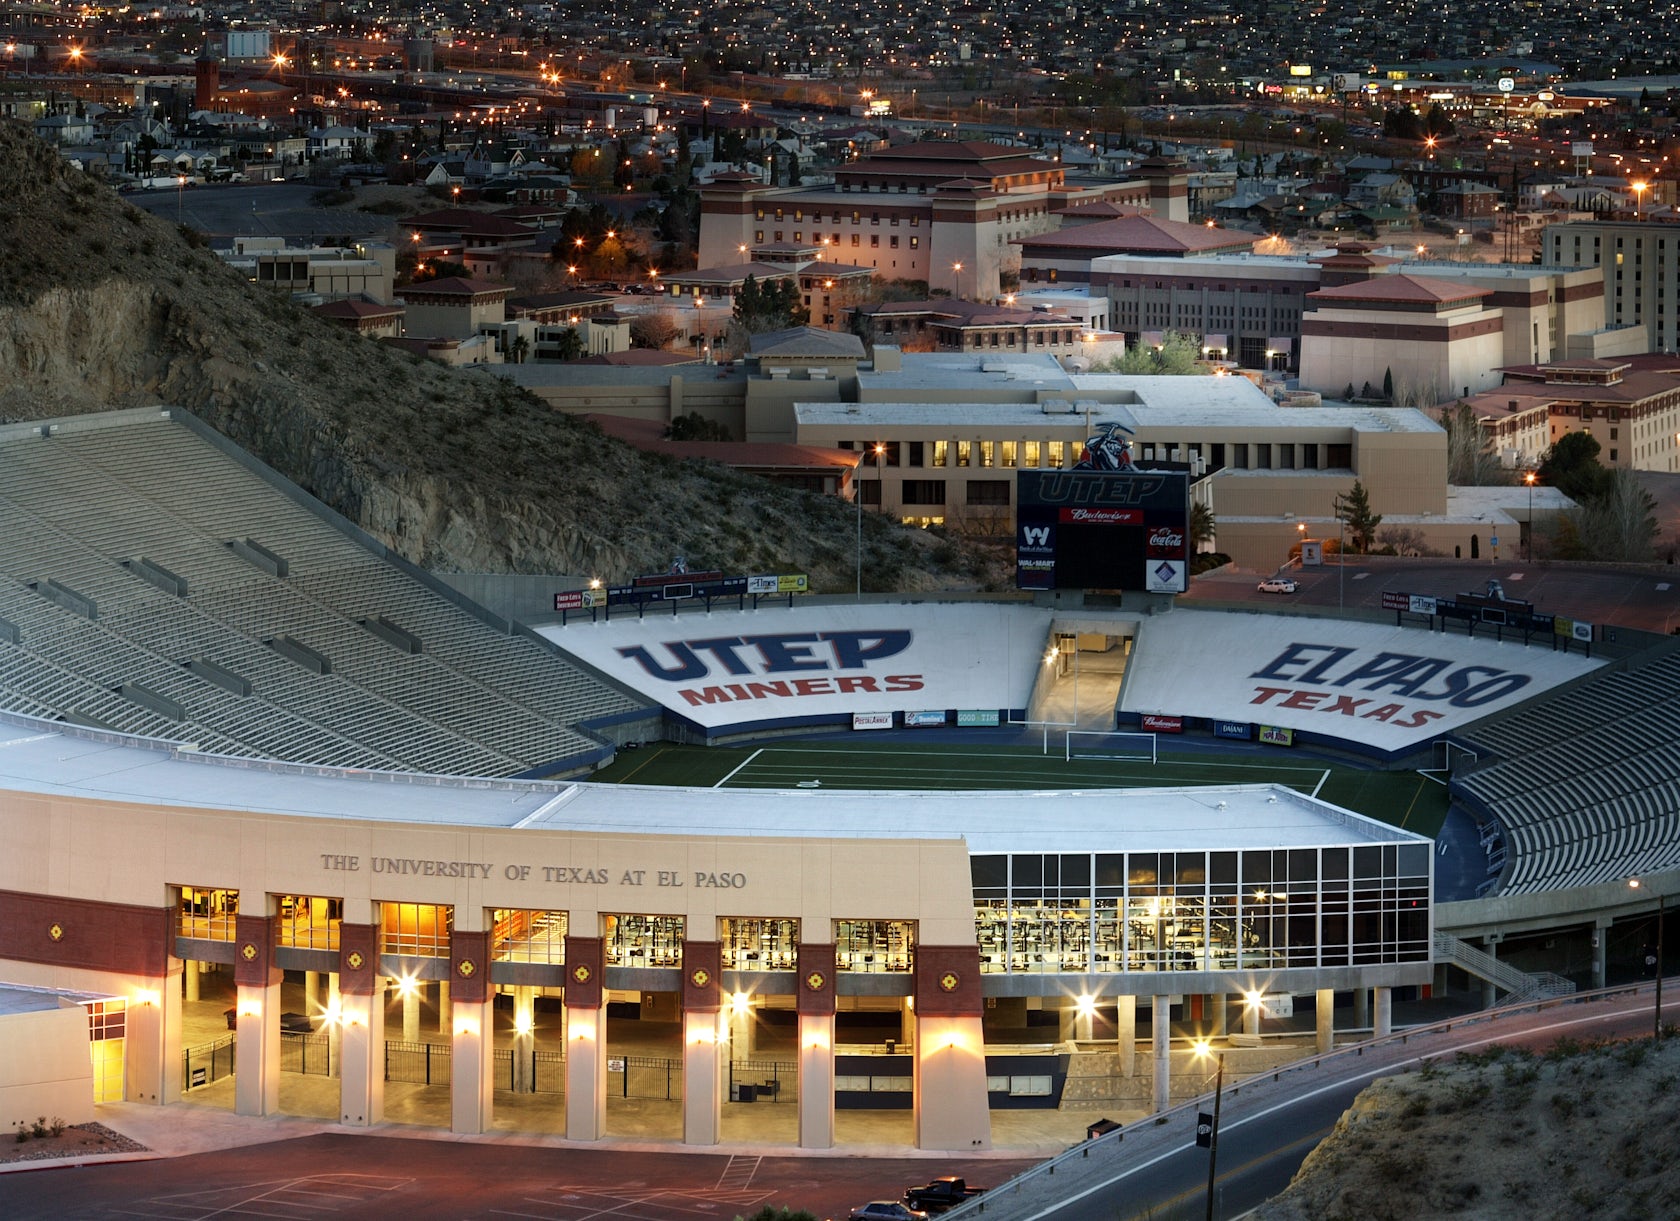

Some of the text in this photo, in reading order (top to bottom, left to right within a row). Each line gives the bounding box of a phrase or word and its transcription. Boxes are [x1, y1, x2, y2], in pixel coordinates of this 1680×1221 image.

[1039, 473, 1165, 504] UTEP
[1071, 508, 1131, 520] Budweiser
[613, 629, 914, 682] UTEP
[677, 674, 925, 707] MINERS
[1249, 642, 1533, 708] EL PASO
[959, 713, 999, 722] GOOD TIME
[1249, 686, 1446, 728] TEXAS
[321, 854, 747, 889] THE UNIVERSITY OF TEXAS AT EL PASO
